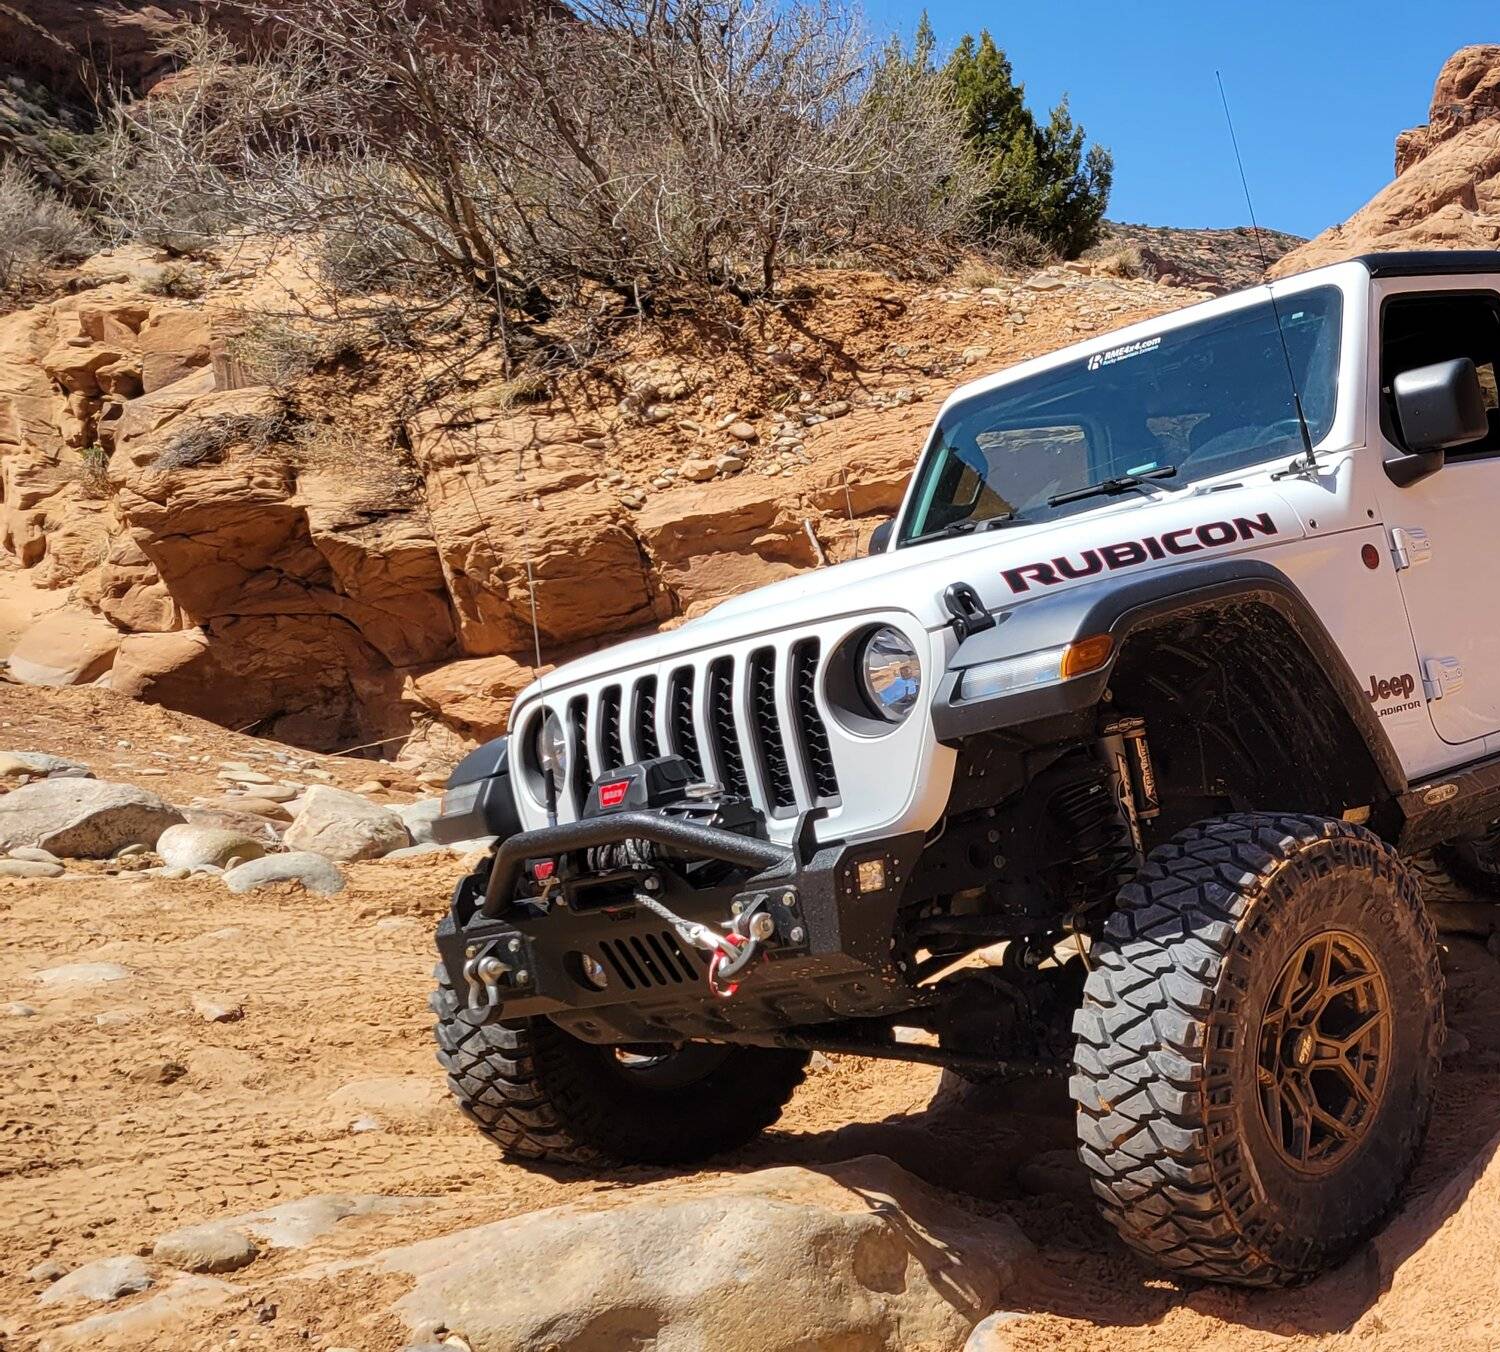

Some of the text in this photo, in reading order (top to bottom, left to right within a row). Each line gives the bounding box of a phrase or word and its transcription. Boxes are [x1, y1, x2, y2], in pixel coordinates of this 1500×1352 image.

[1104, 337, 1161, 360] RME4x4.com
[1000, 512, 1279, 594] RUBICON
[1363, 673, 1415, 703] Jeep
[1376, 700, 1421, 718] LADIATOR
